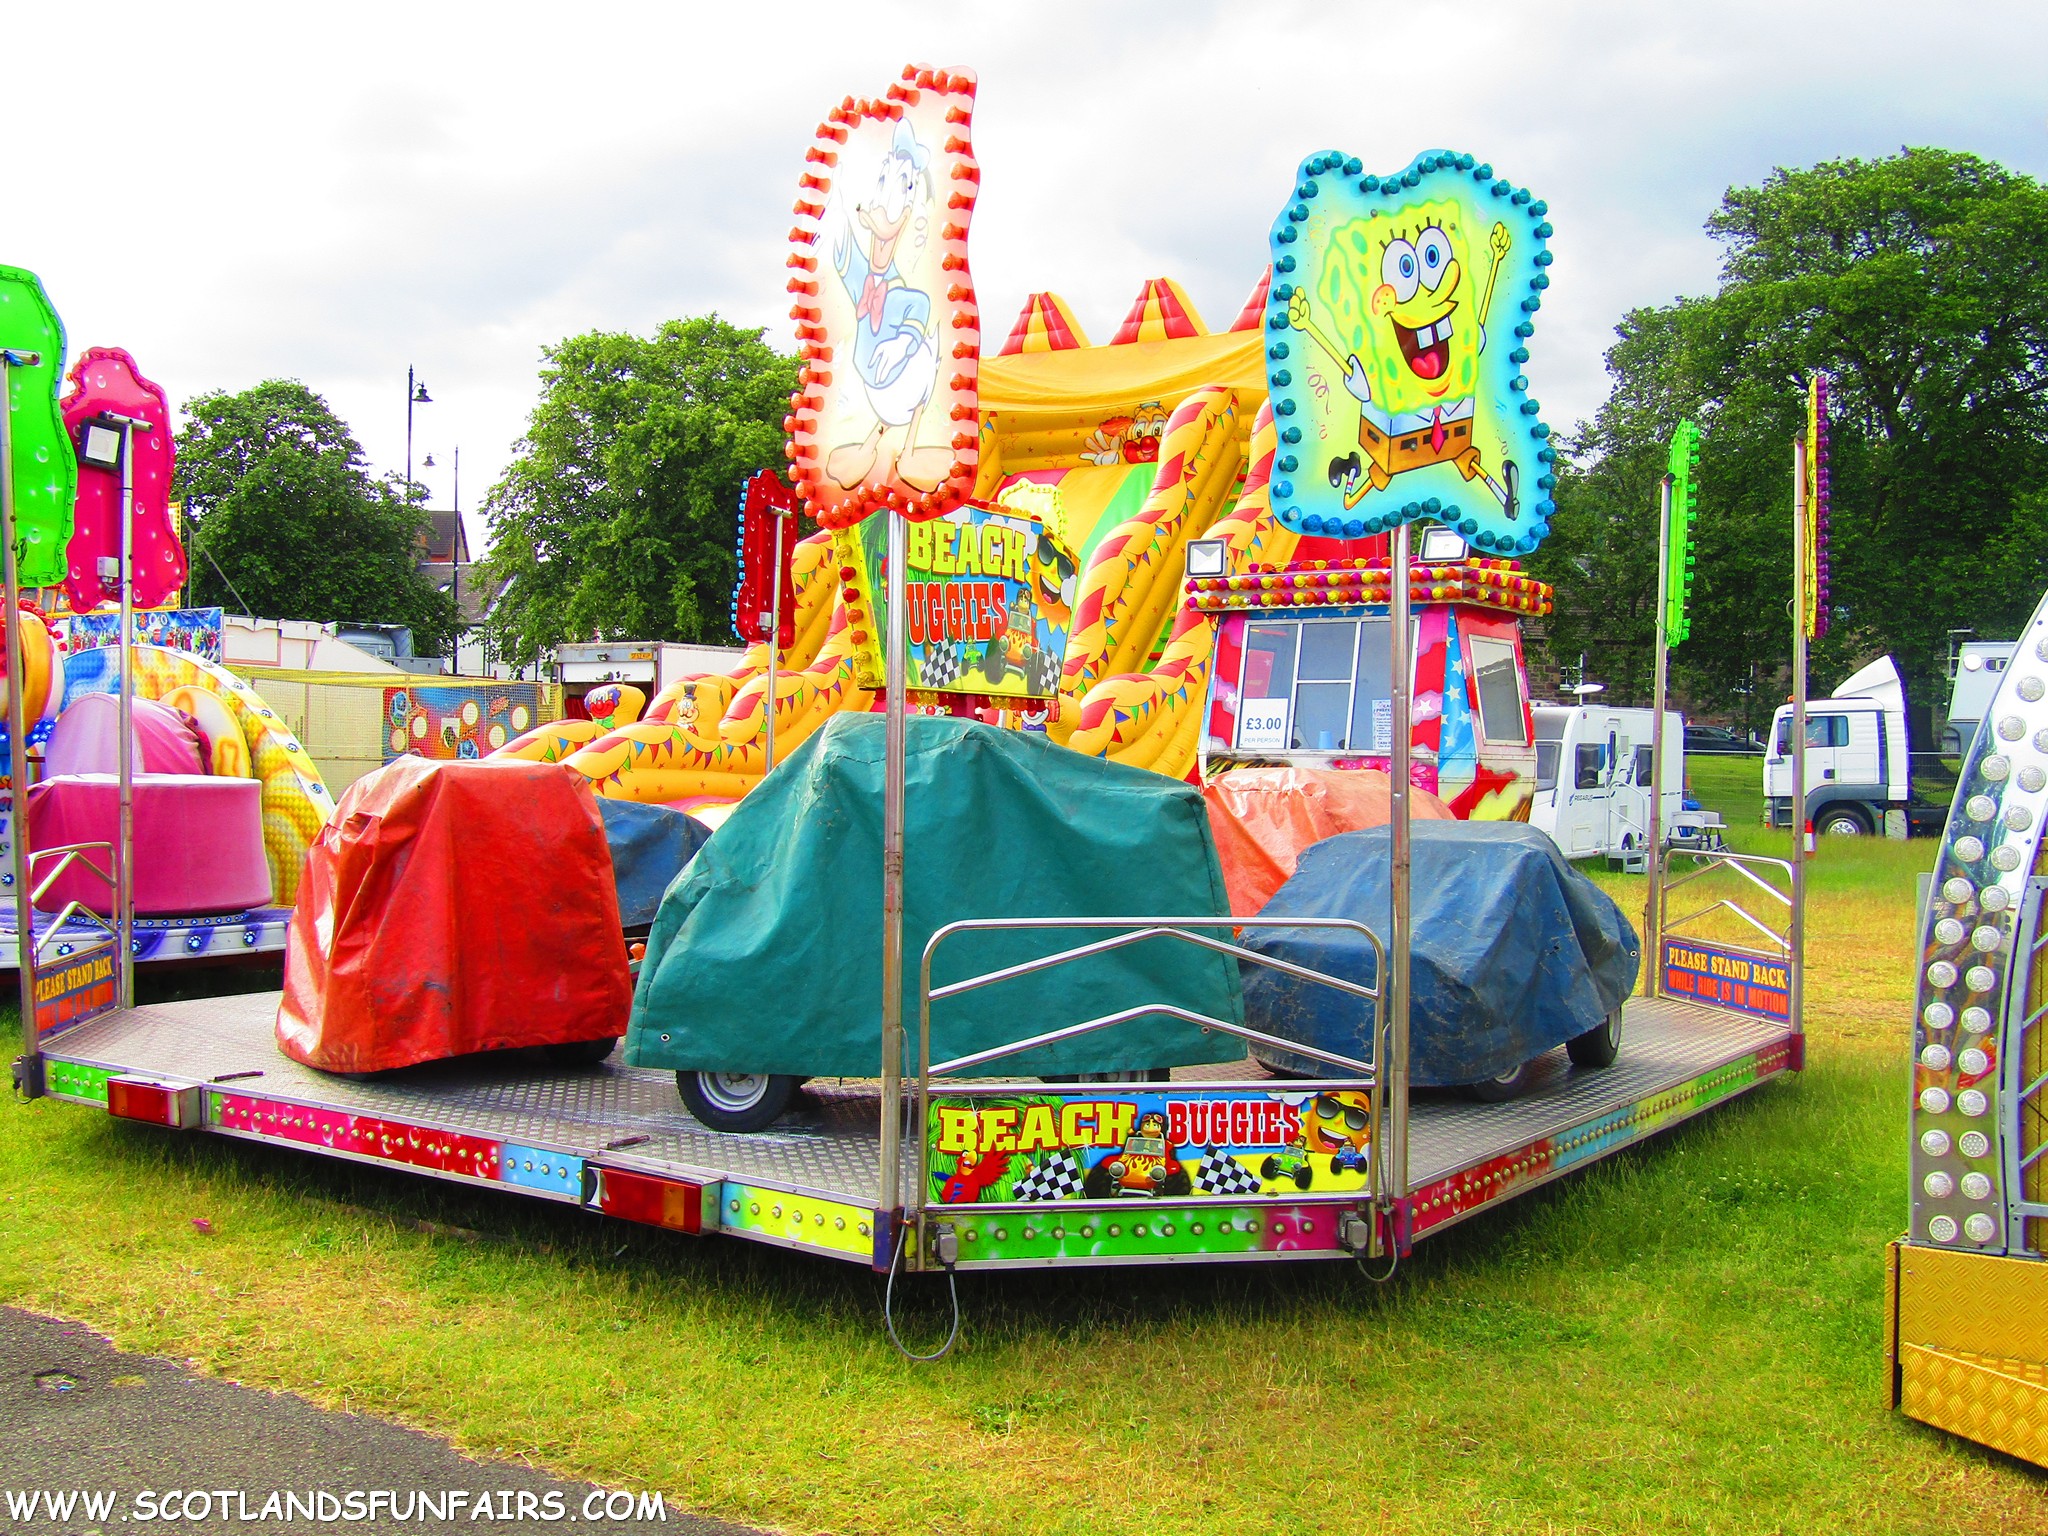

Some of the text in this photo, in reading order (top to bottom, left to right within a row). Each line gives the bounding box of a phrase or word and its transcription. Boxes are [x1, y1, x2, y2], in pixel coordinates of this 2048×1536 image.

[907, 520, 1026, 585] BEACH
[885, 581, 1008, 646] UGGIES
[1245, 717, 1282, 730] £3.00
[67, 962, 93, 991] STAND
[94, 955, 113, 981] BACK
[1668, 947, 1787, 990] PLEASE STAND BACK
[1668, 969, 1788, 1015] WHILE RIDE IS IN MOTION
[938, 1099, 1303, 1155] BEACH BUGGIES
